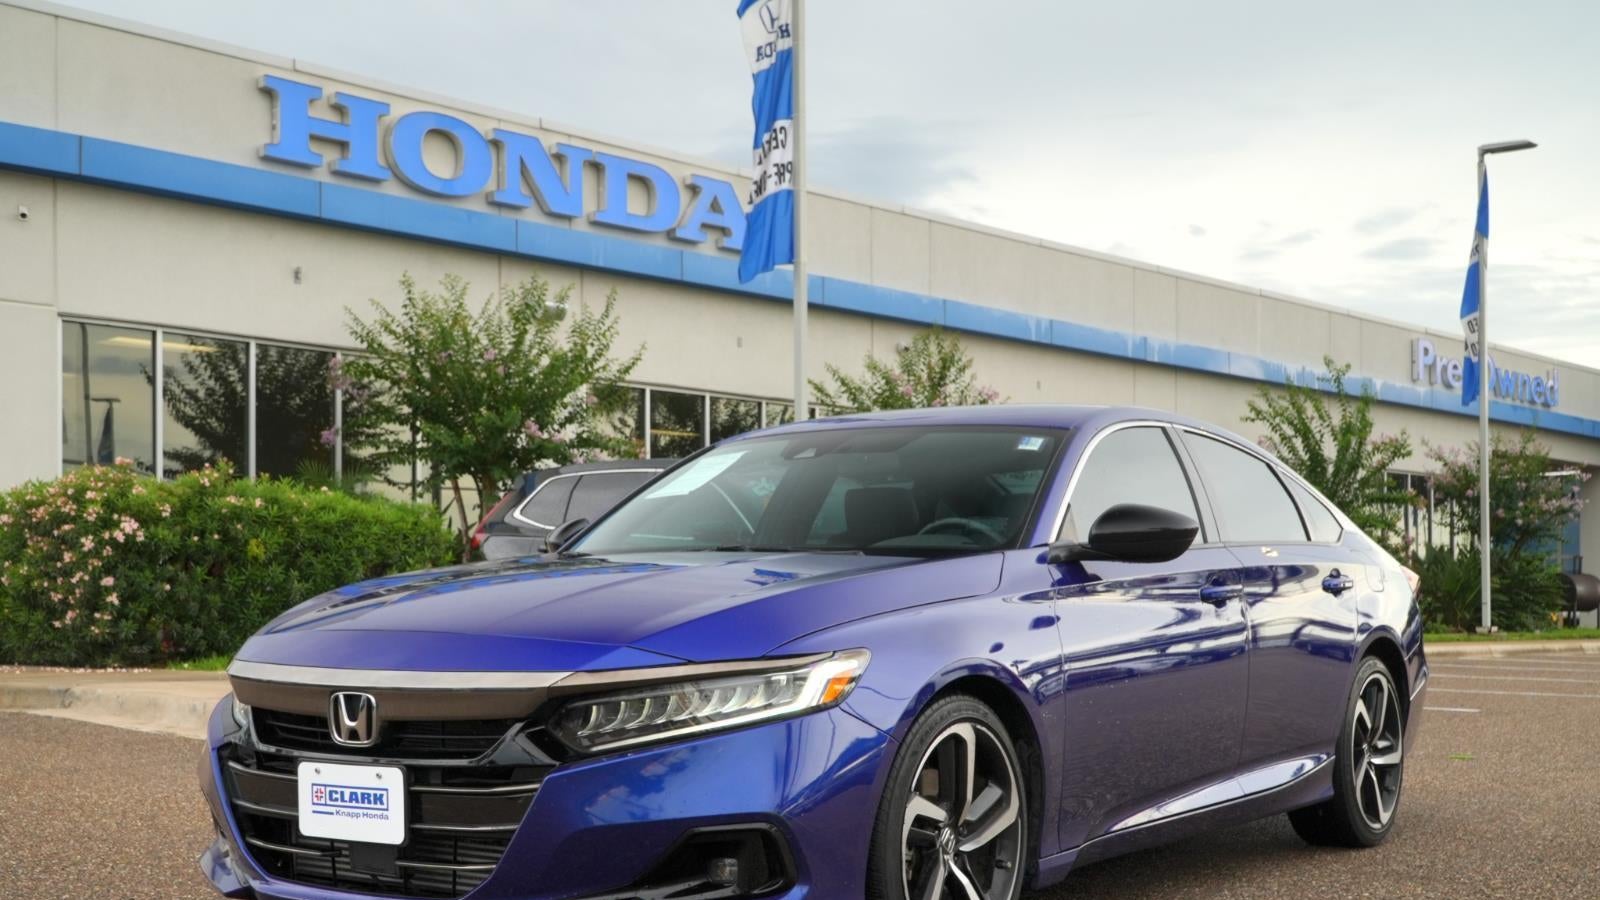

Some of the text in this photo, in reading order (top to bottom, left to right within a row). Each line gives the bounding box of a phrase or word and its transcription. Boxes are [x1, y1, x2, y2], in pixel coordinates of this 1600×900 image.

[258, 74, 748, 252] HONDA
[328, 789, 385, 806] CLARK
[335, 809, 389, 820] Knapp Honda
